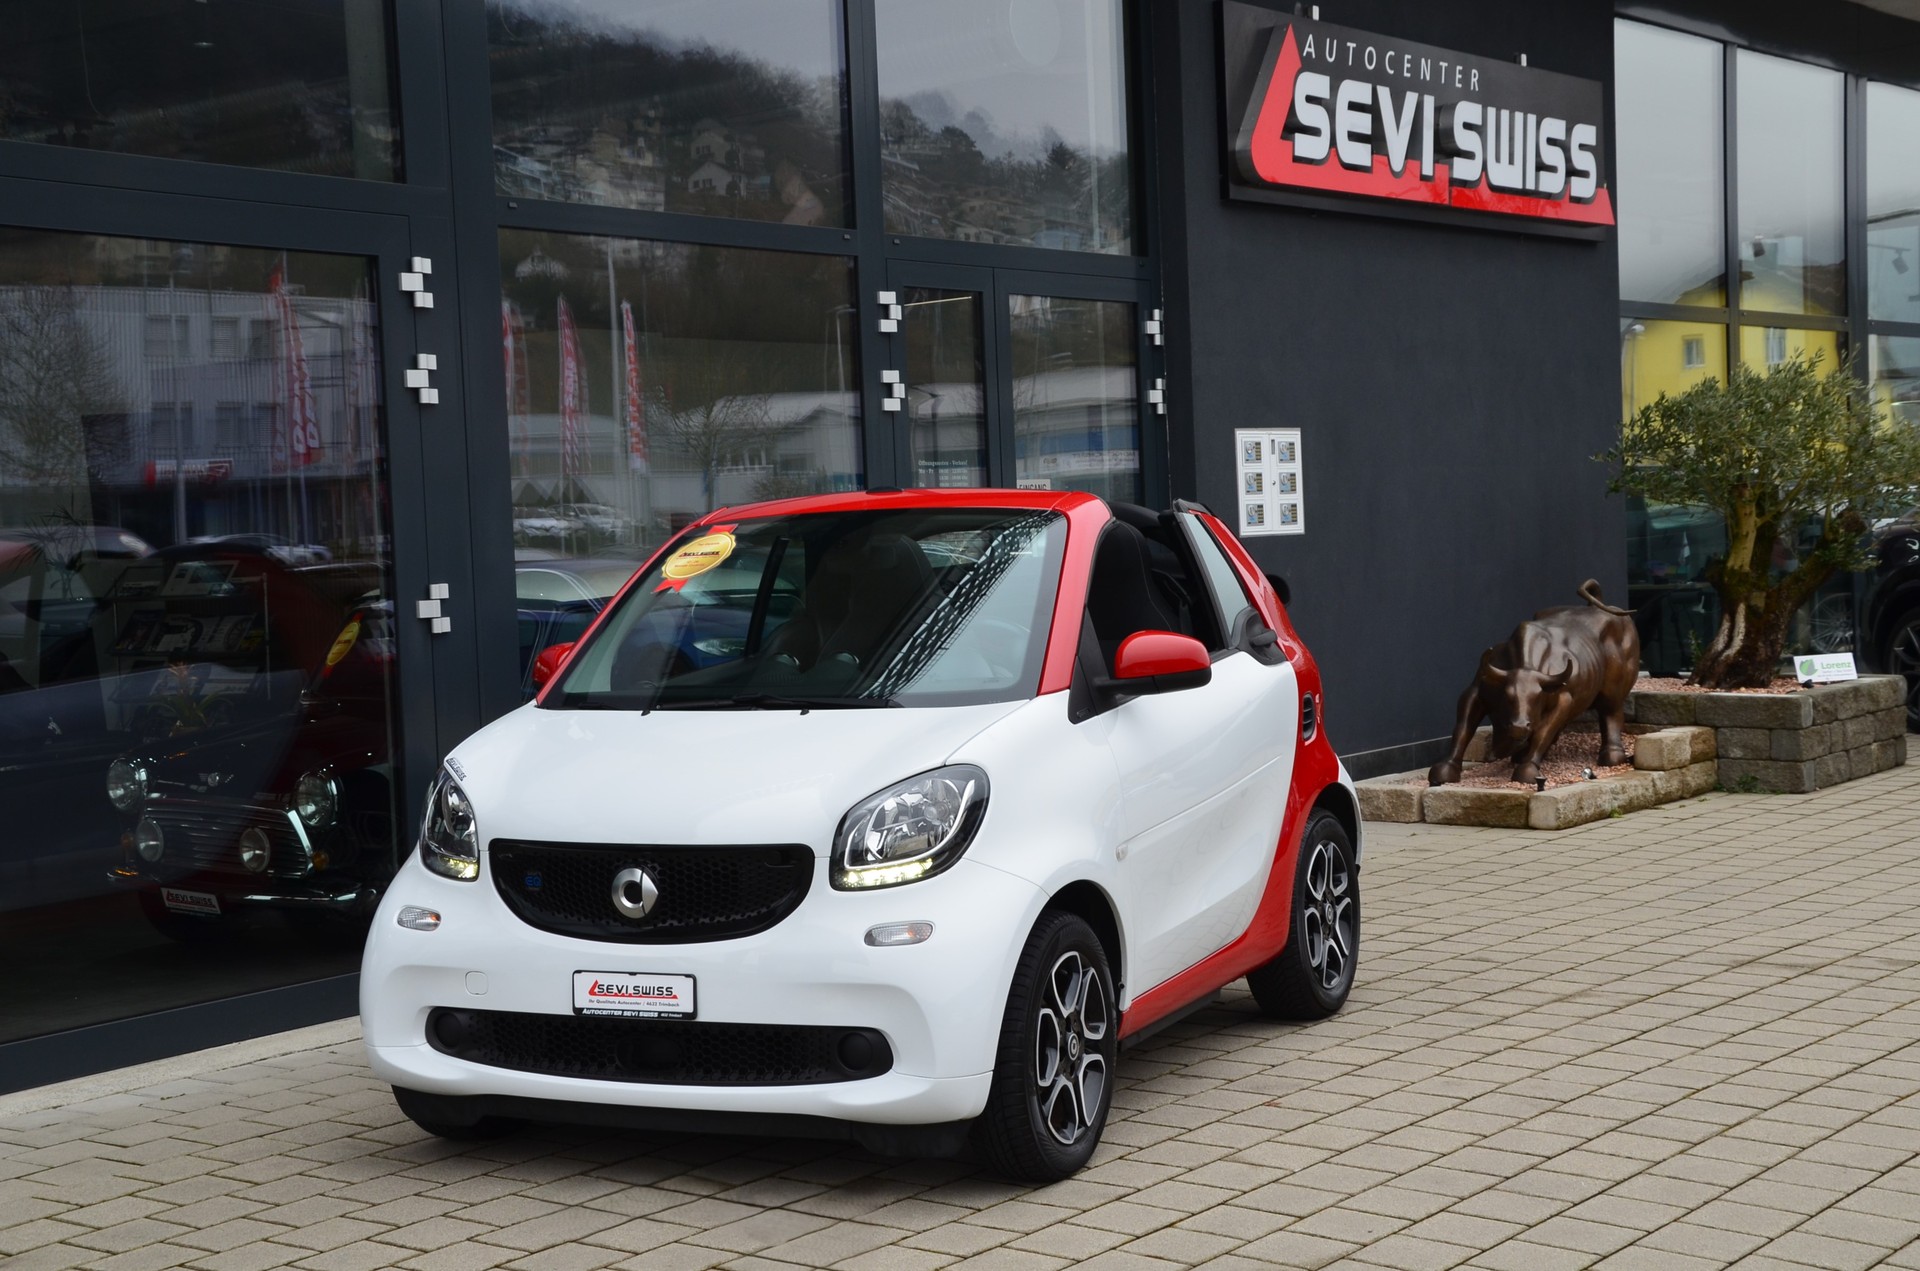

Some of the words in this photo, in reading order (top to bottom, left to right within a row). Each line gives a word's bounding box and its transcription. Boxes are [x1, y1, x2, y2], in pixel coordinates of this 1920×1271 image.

[1303, 33, 1481, 92] AUTOCENTER
[1292, 71, 1435, 176] SEVI
[1452, 100, 1597, 199] SWISS
[1821, 661, 1852, 669] Lorenz
[525, 876, 542, 887] EQ
[597, 984, 628, 995] SEVI
[632, 986, 673, 996] SWISS
